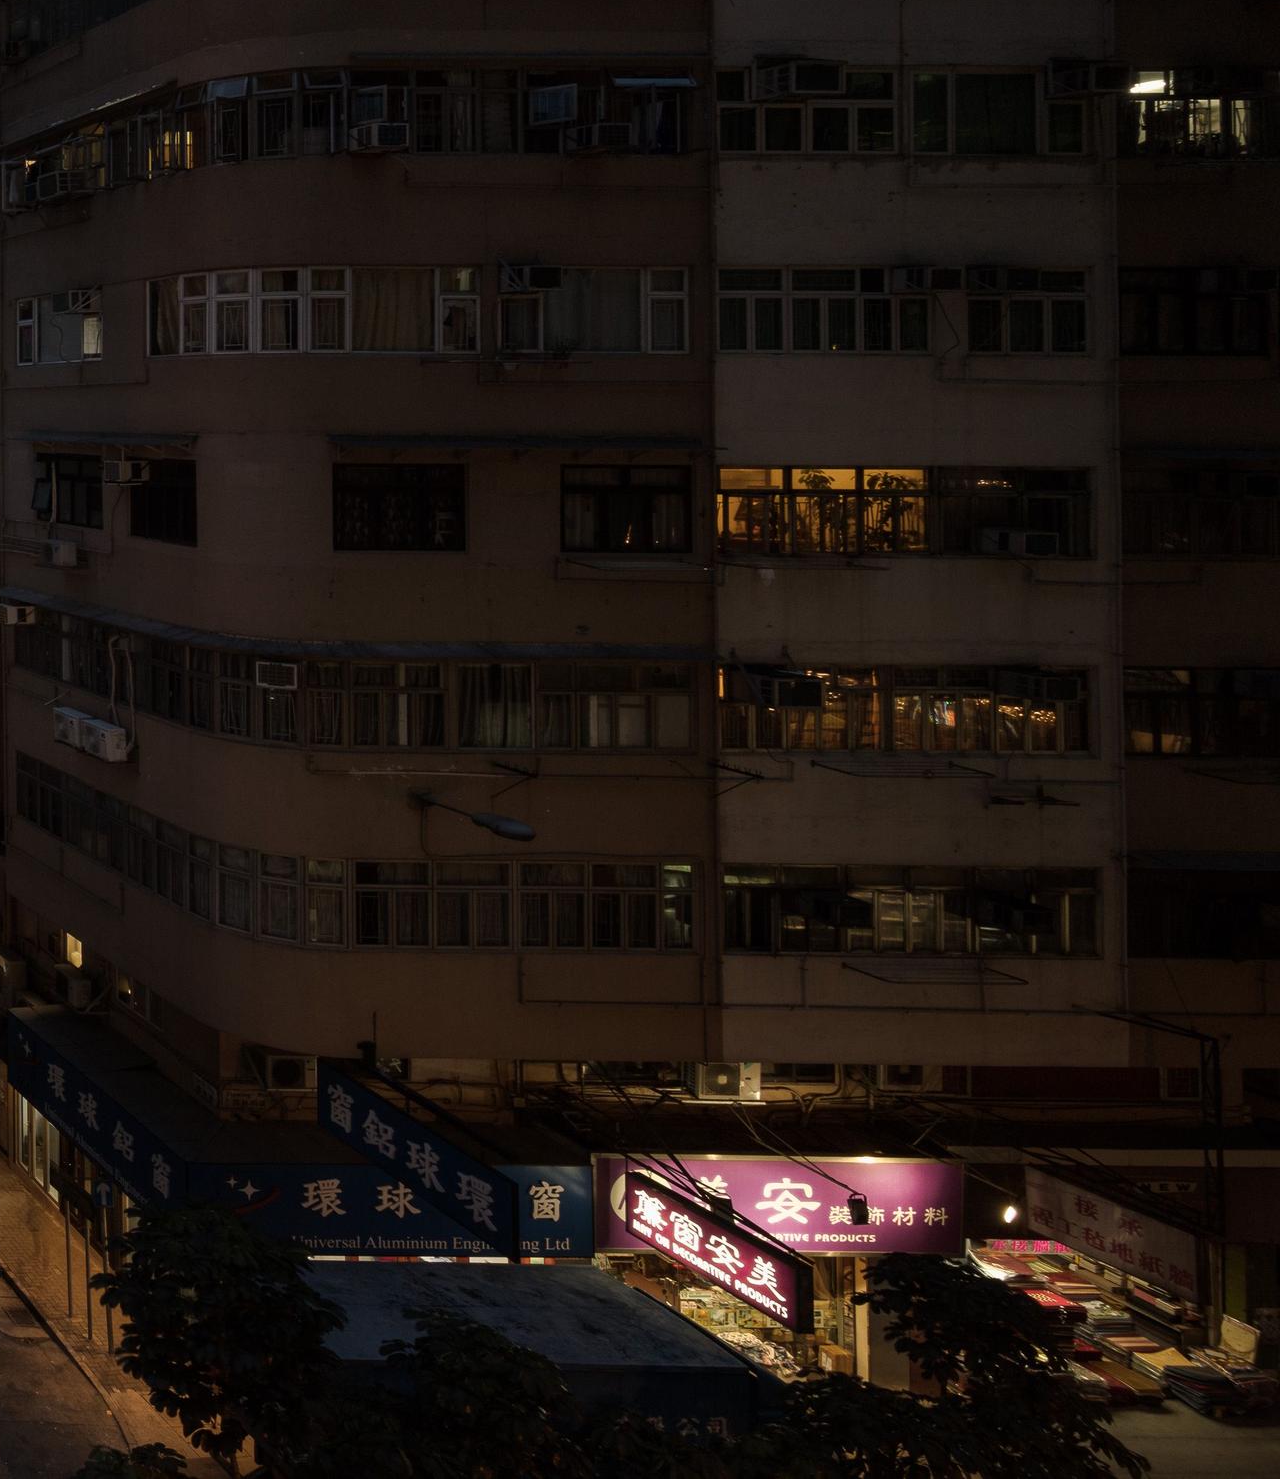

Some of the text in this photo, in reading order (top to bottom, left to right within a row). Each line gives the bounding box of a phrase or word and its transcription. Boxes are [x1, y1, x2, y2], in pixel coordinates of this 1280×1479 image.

[47, 1062, 172, 1200] 環球鋁窗
[327, 1081, 498, 1233] 環球鋁窗
[293, 1235, 360, 1249] niversal
[365, 1235, 448, 1249] Aluminium
[544, 1237, 571, 1250] Ltd
[633, 1189, 786, 1303] 美安窗簾
[672, 1242, 732, 1286] DECORATIVE
[734, 1279, 788, 1319] PRODUCTS
[814, 1233, 877, 1243] PRODUCTS
